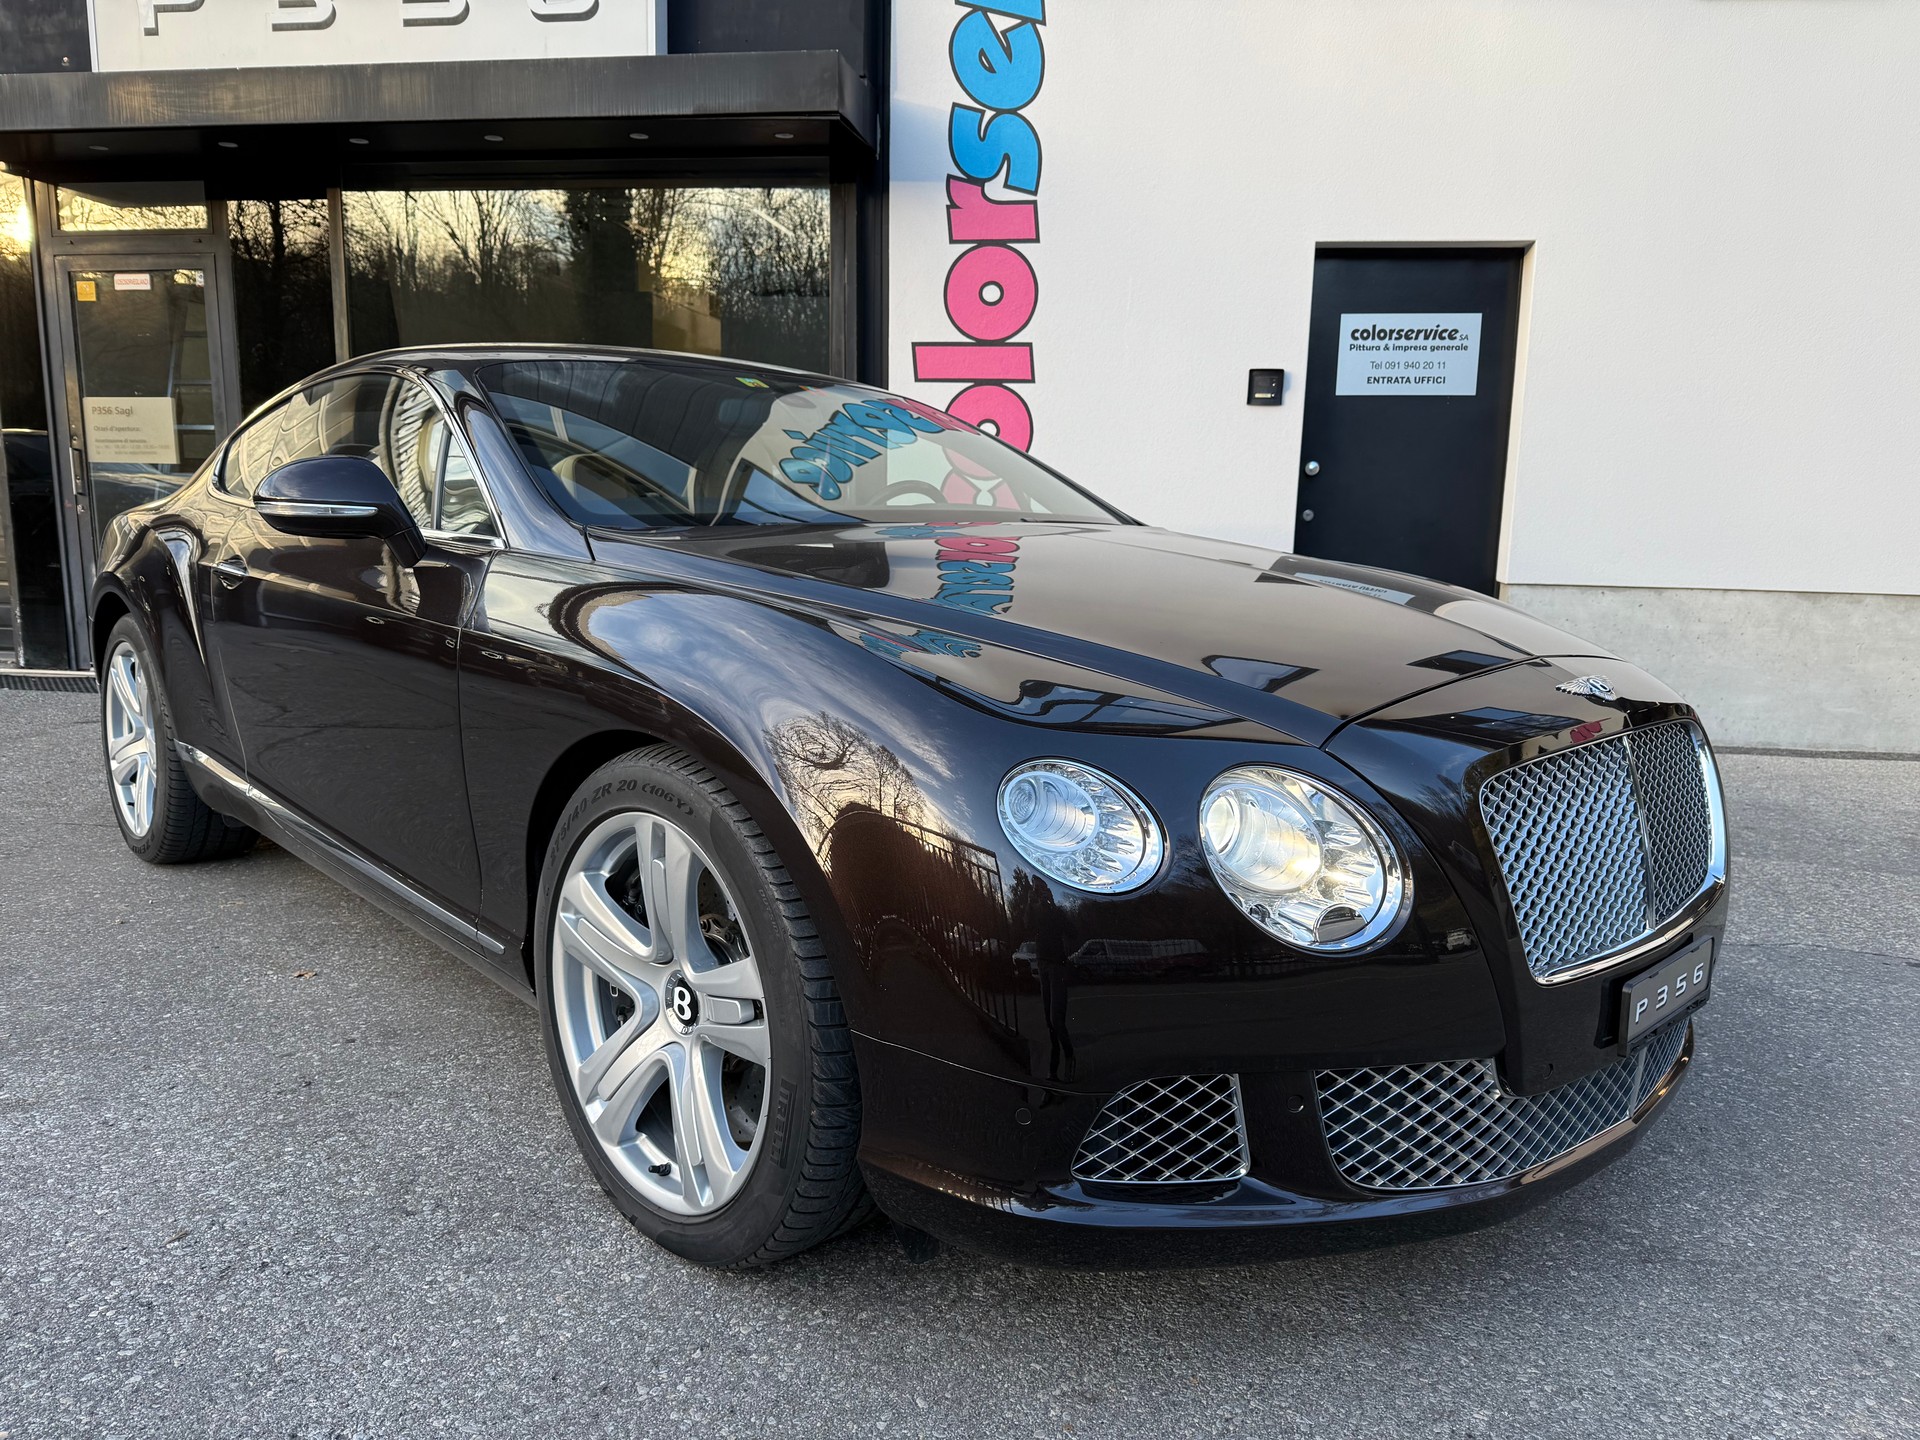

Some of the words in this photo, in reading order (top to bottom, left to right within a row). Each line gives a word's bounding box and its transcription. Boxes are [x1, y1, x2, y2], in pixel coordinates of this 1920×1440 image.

[1350, 324, 1459, 341] colorservice
[1349, 343, 1381, 352] Pittura
[1429, 343, 1469, 353] generale
[1370, 361, 1382, 370] Tel
[1384, 361, 1400, 370] 091
[1403, 361, 1420, 370] 940
[1422, 361, 1434, 370] 20
[1437, 361, 1446, 370] 11
[1366, 376, 1412, 385] ENTRATA
[1414, 376, 1446, 385] UFFICI
[590, 782, 613, 805] ZR
[616, 779, 638, 792] 20
